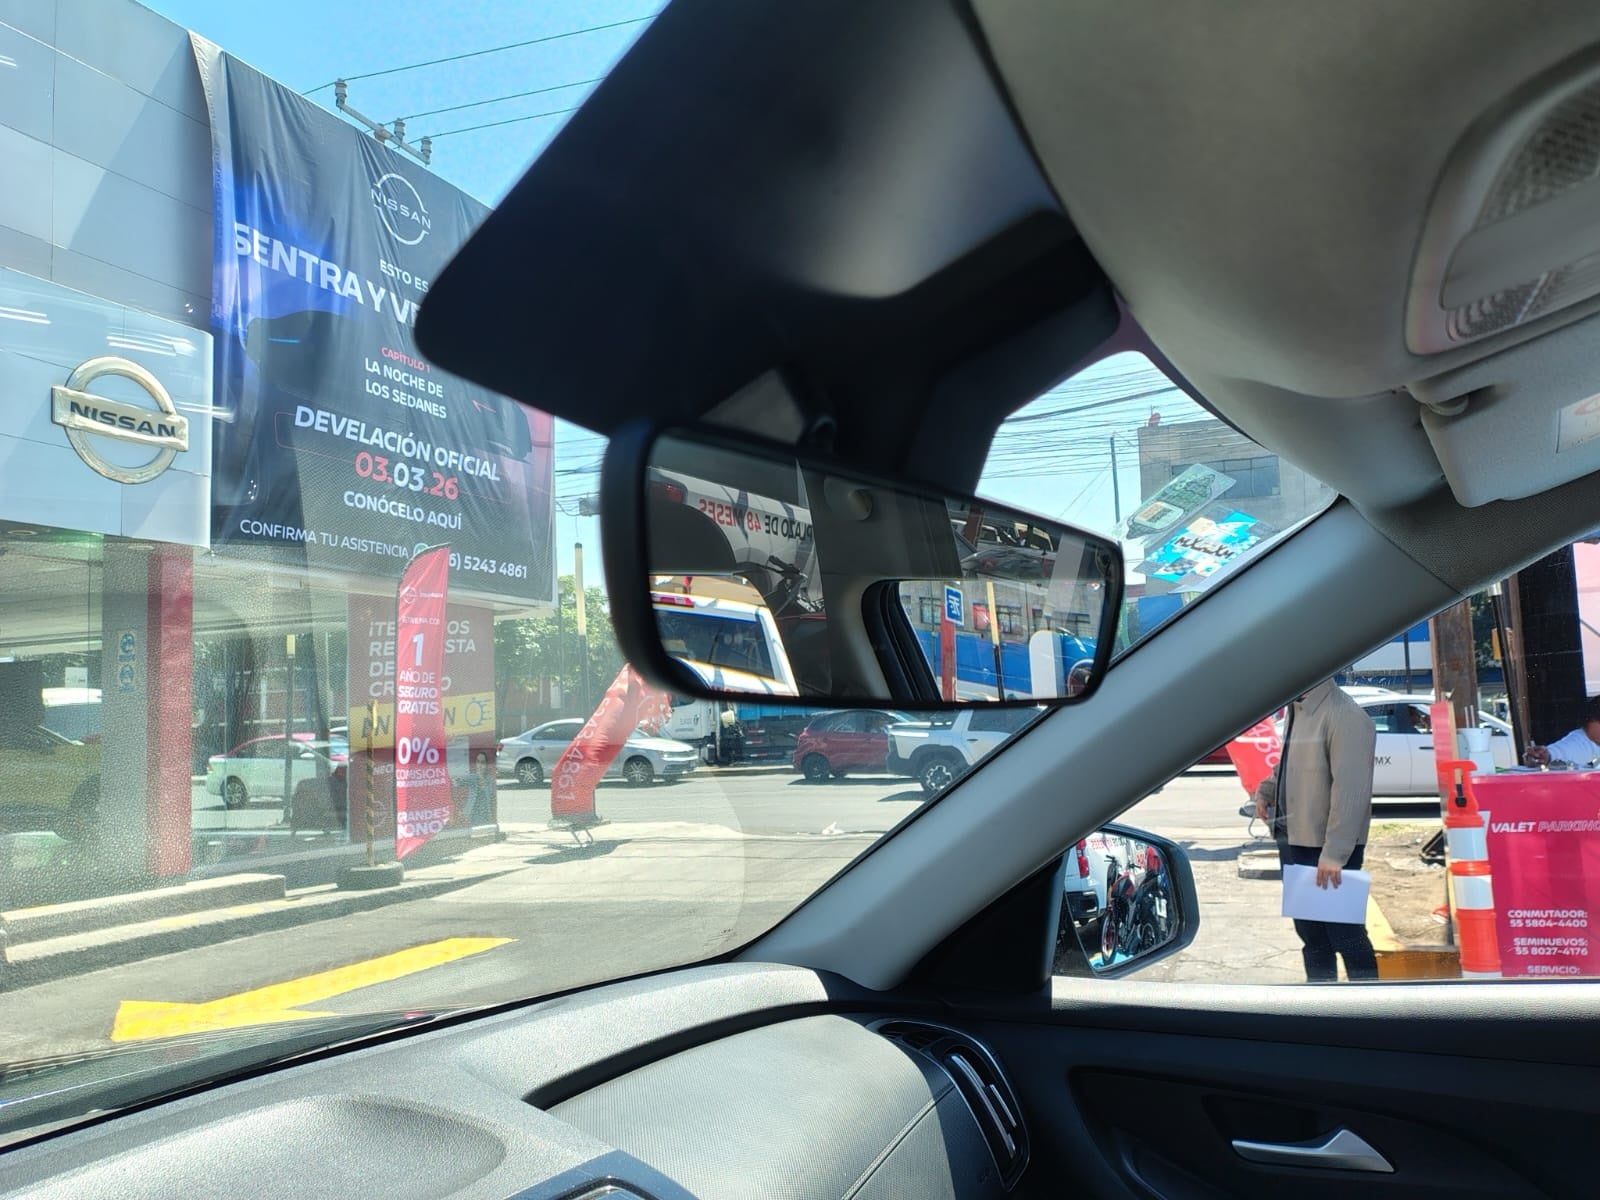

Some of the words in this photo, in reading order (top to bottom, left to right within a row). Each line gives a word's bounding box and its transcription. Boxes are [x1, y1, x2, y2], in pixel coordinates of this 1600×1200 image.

[370, 188, 431, 229] NISSAN
[234, 221, 364, 304] SENTRA
[366, 280, 386, 313] Y
[379, 259, 412, 285] ESTO
[414, 277, 429, 293] ES
[381, 346, 425, 371] CAPÍTULO
[426, 363, 431, 374] 1
[365, 357, 381, 376] LA
[383, 364, 425, 392] NOCHE
[427, 380, 443, 398] DE
[365, 378, 390, 399] LOS
[392, 391, 447, 419] SEDANES
[70, 401, 176, 437] NISSAN
[294, 405, 431, 462] DEVELACIÓN
[434, 447, 501, 482] OFICIAL
[355, 451, 459, 500] 03.03.26
[343, 490, 424, 523] CONÓCELO
[427, 511, 462, 530] AQUÍ
[239, 519, 317, 544] CONFIRMA
[319, 531, 339, 547] TU
[340, 535, 409, 559] ASISTENCIA
[463, 554, 497, 574] 5243
[499, 560, 528, 579] 4861
[412, 632, 424, 666] 1
[400, 667, 420, 684] AÑO
[421, 672, 436, 684] DE
[398, 685, 438, 699] SEGURO
[397, 700, 440, 715] GRATIS
[398, 736, 440, 765] 0%
[1374, 756, 1392, 765] MX
[1491, 821, 1537, 833] VALET
[1507, 909, 1588, 919] CONMUTADOR:
[1509, 918, 1524, 928] 55
[1525, 918, 1588, 928] 5804-4400
[1513, 937, 1588, 947] SEMINUEVOS:
[1515, 946, 1529, 956] 55
[1531, 946, 1588, 956] 8027-4176
[1527, 965, 1581, 974] SERVICIO:
